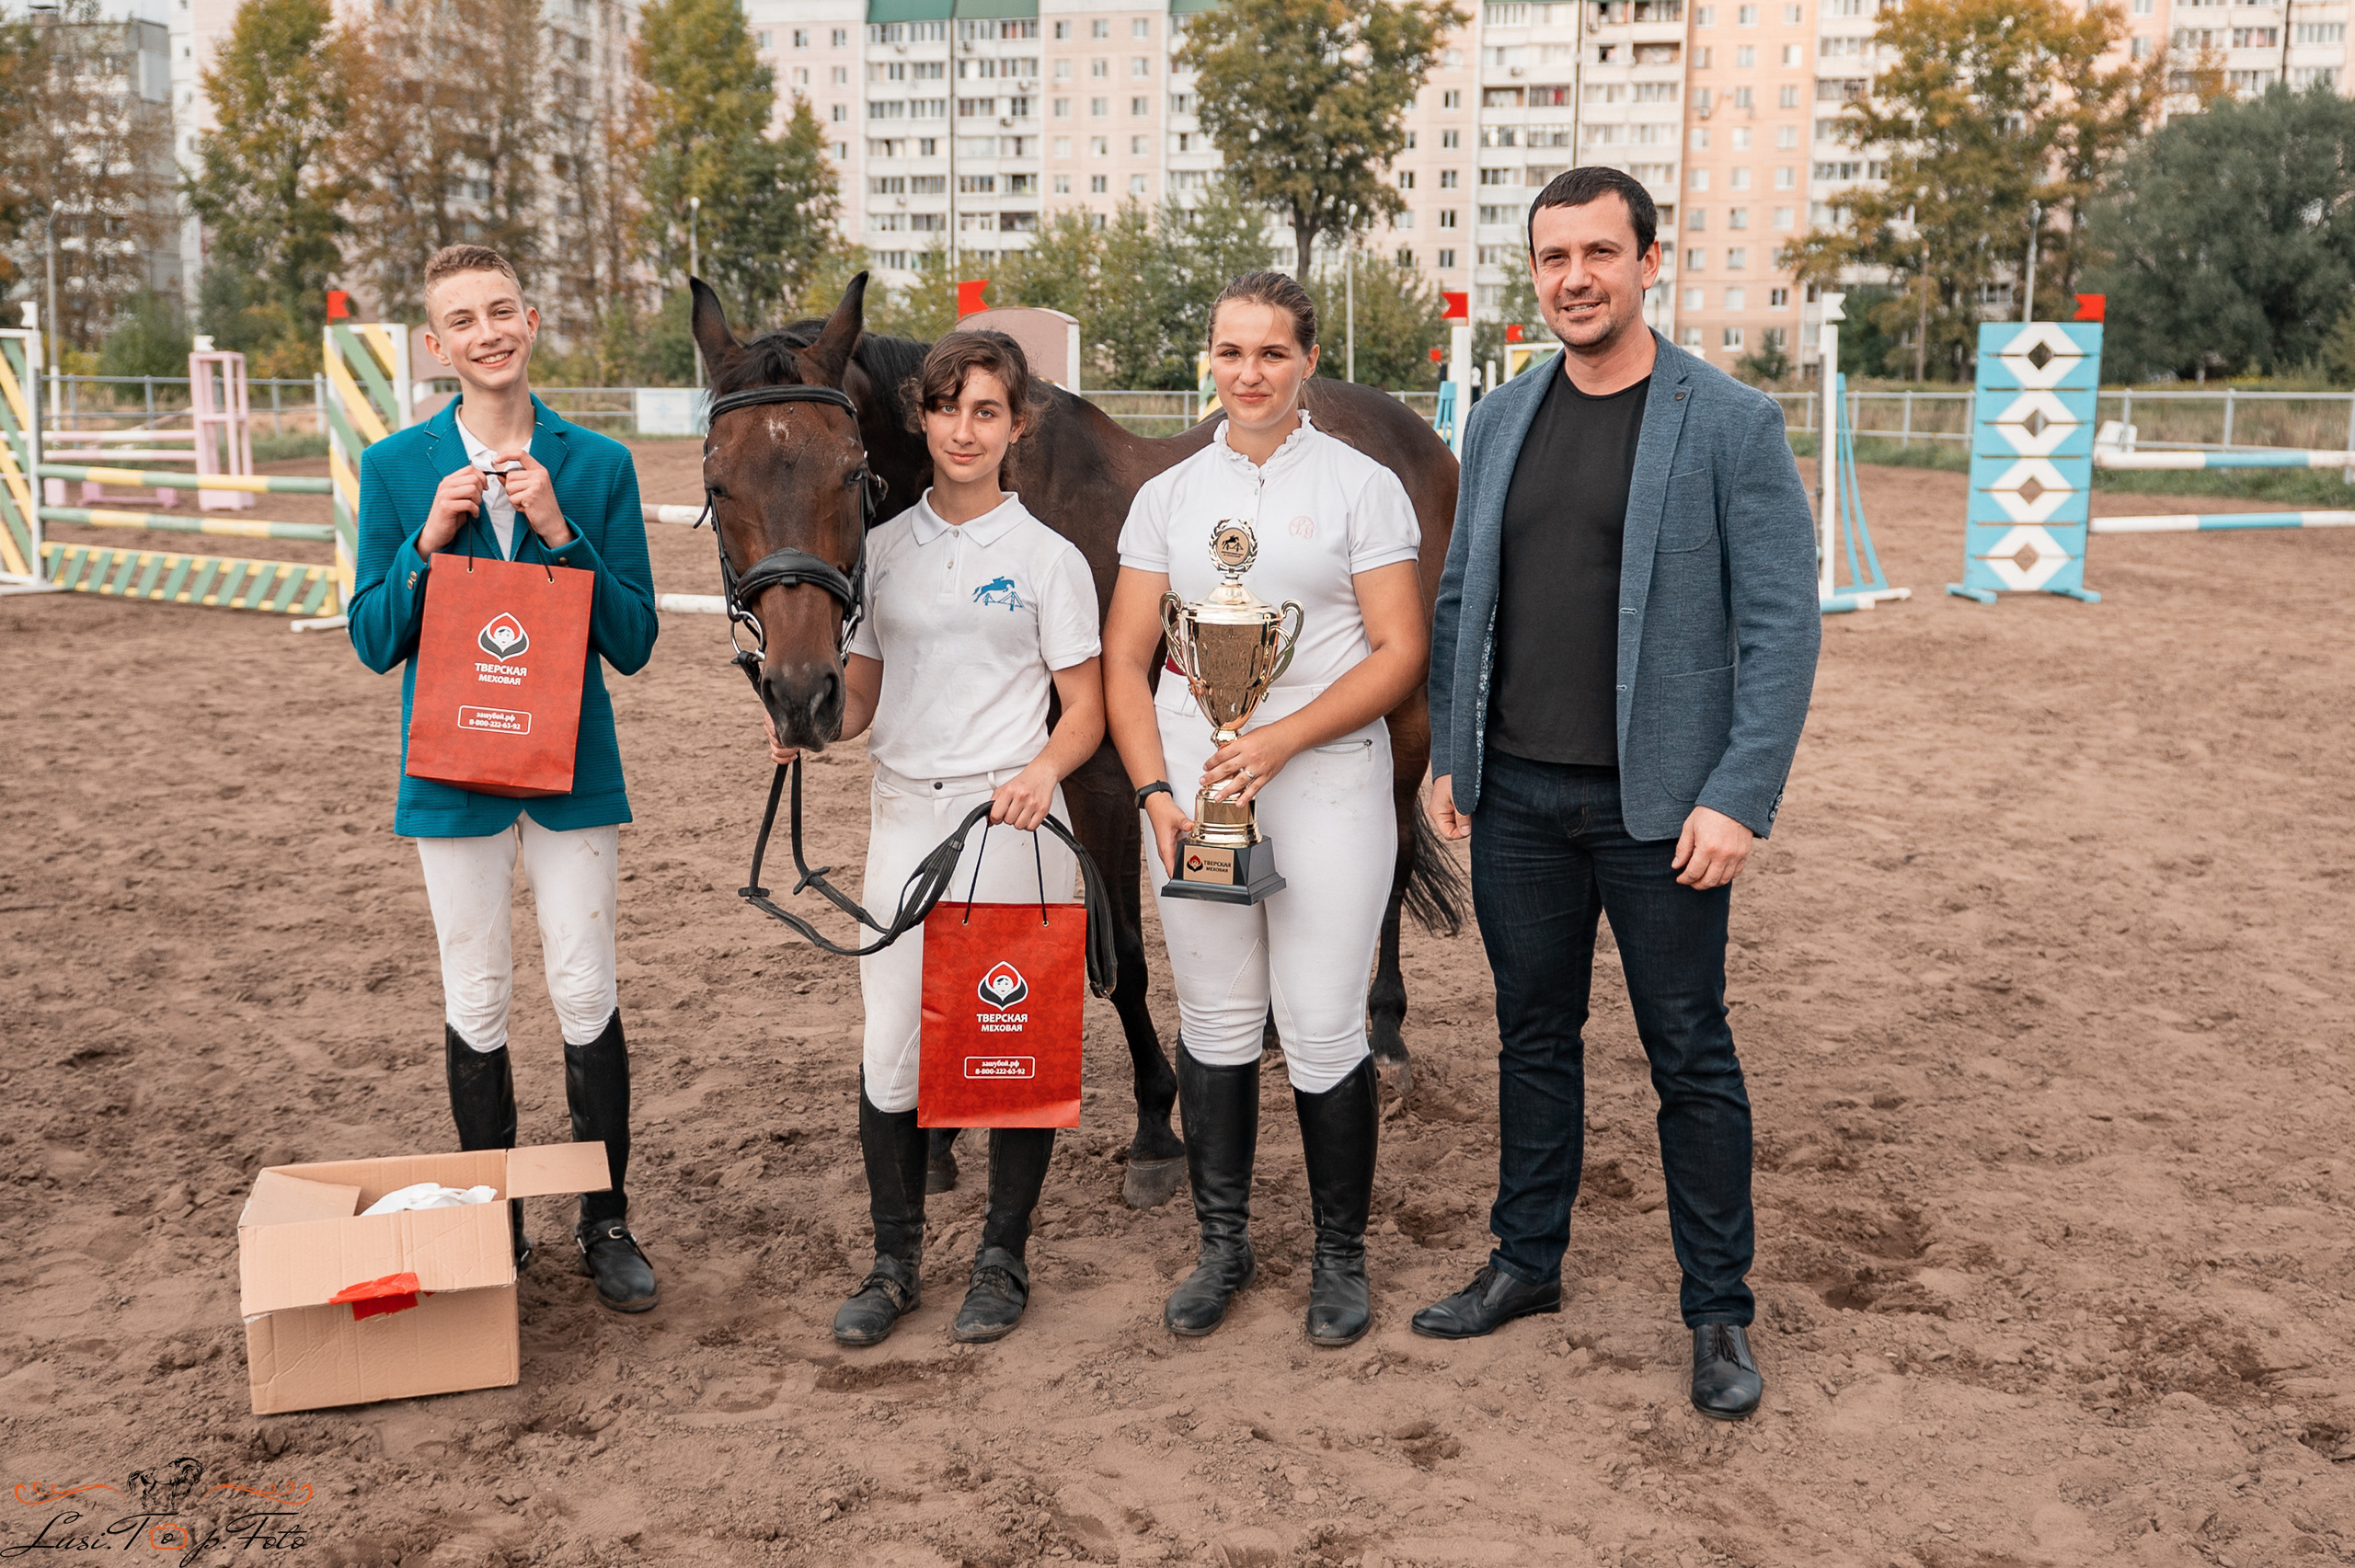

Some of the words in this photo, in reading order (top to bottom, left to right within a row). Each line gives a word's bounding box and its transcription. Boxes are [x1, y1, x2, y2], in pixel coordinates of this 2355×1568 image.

[474, 662, 527, 676] ТВЕРСКАЯ
[478, 673, 521, 686] МЕХОВАЯ
[976, 1013, 1028, 1023] ТВЕРСКАЯ
[981, 1024, 1023, 1032] МЕХОВАЯ
